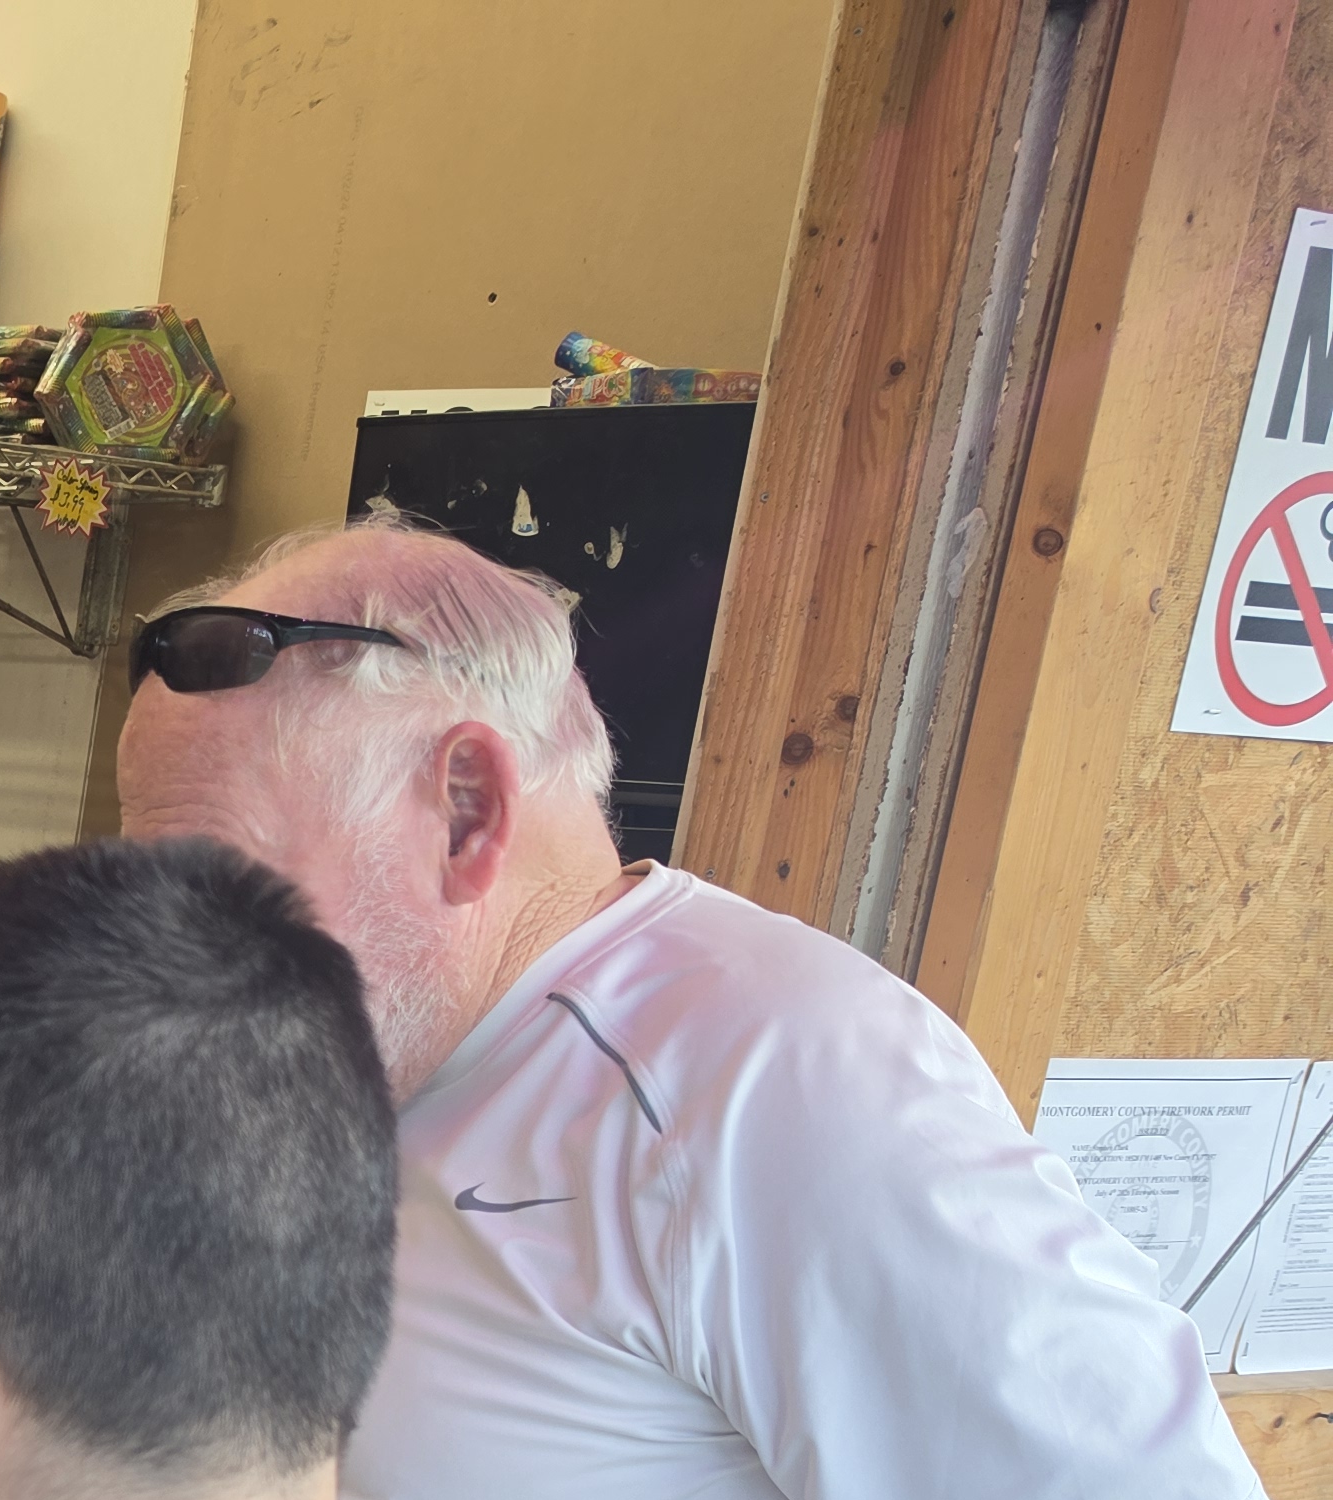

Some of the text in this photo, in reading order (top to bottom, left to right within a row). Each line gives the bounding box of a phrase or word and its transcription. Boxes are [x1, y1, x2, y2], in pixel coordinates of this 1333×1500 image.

[1040, 1105, 1252, 1117] MONTGOMERY COUNTY FIREWORK PERMIT
